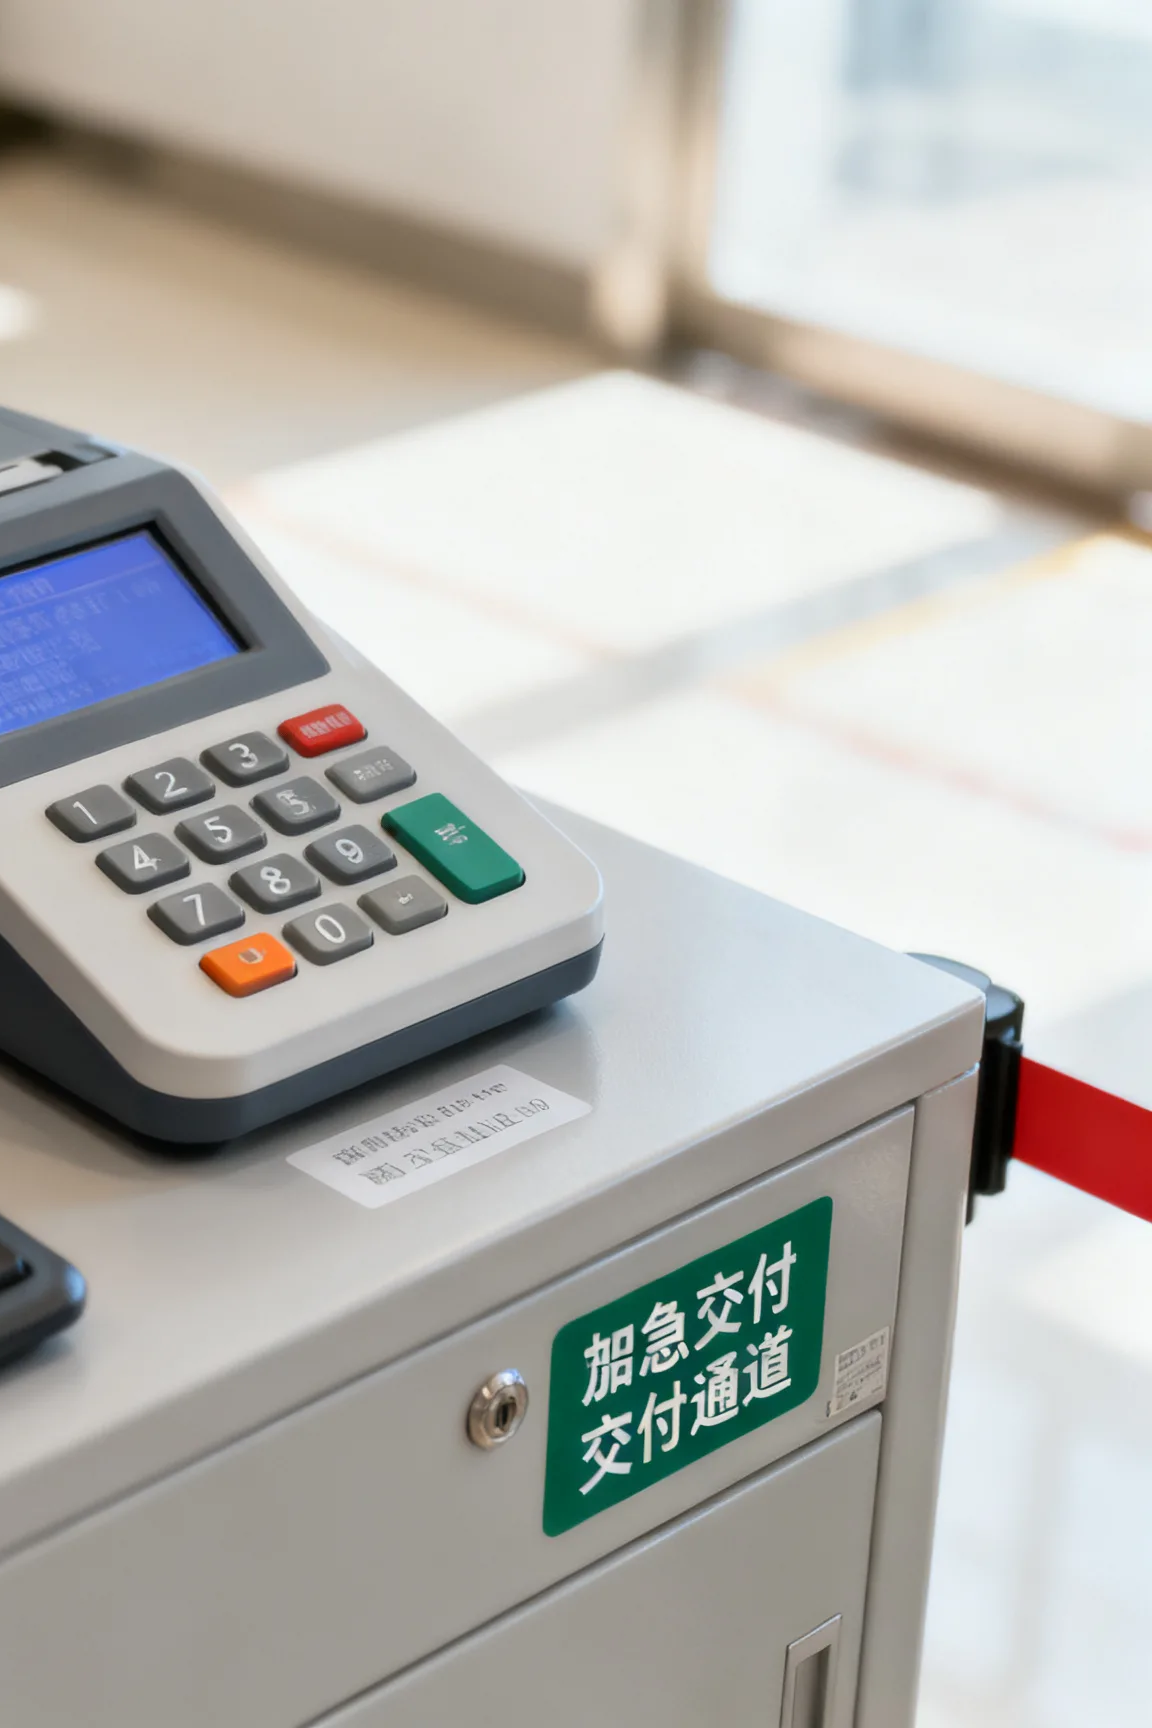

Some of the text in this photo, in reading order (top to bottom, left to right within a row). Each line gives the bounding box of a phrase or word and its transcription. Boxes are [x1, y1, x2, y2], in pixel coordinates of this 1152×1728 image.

[73, 743, 259, 825] 1 2 3
[132, 844, 161, 871] 4
[203, 816, 233, 844] 5
[182, 838, 364, 926] 7 8 9
[314, 914, 346, 944] 0
[578, 1324, 793, 1496] 交付通道
